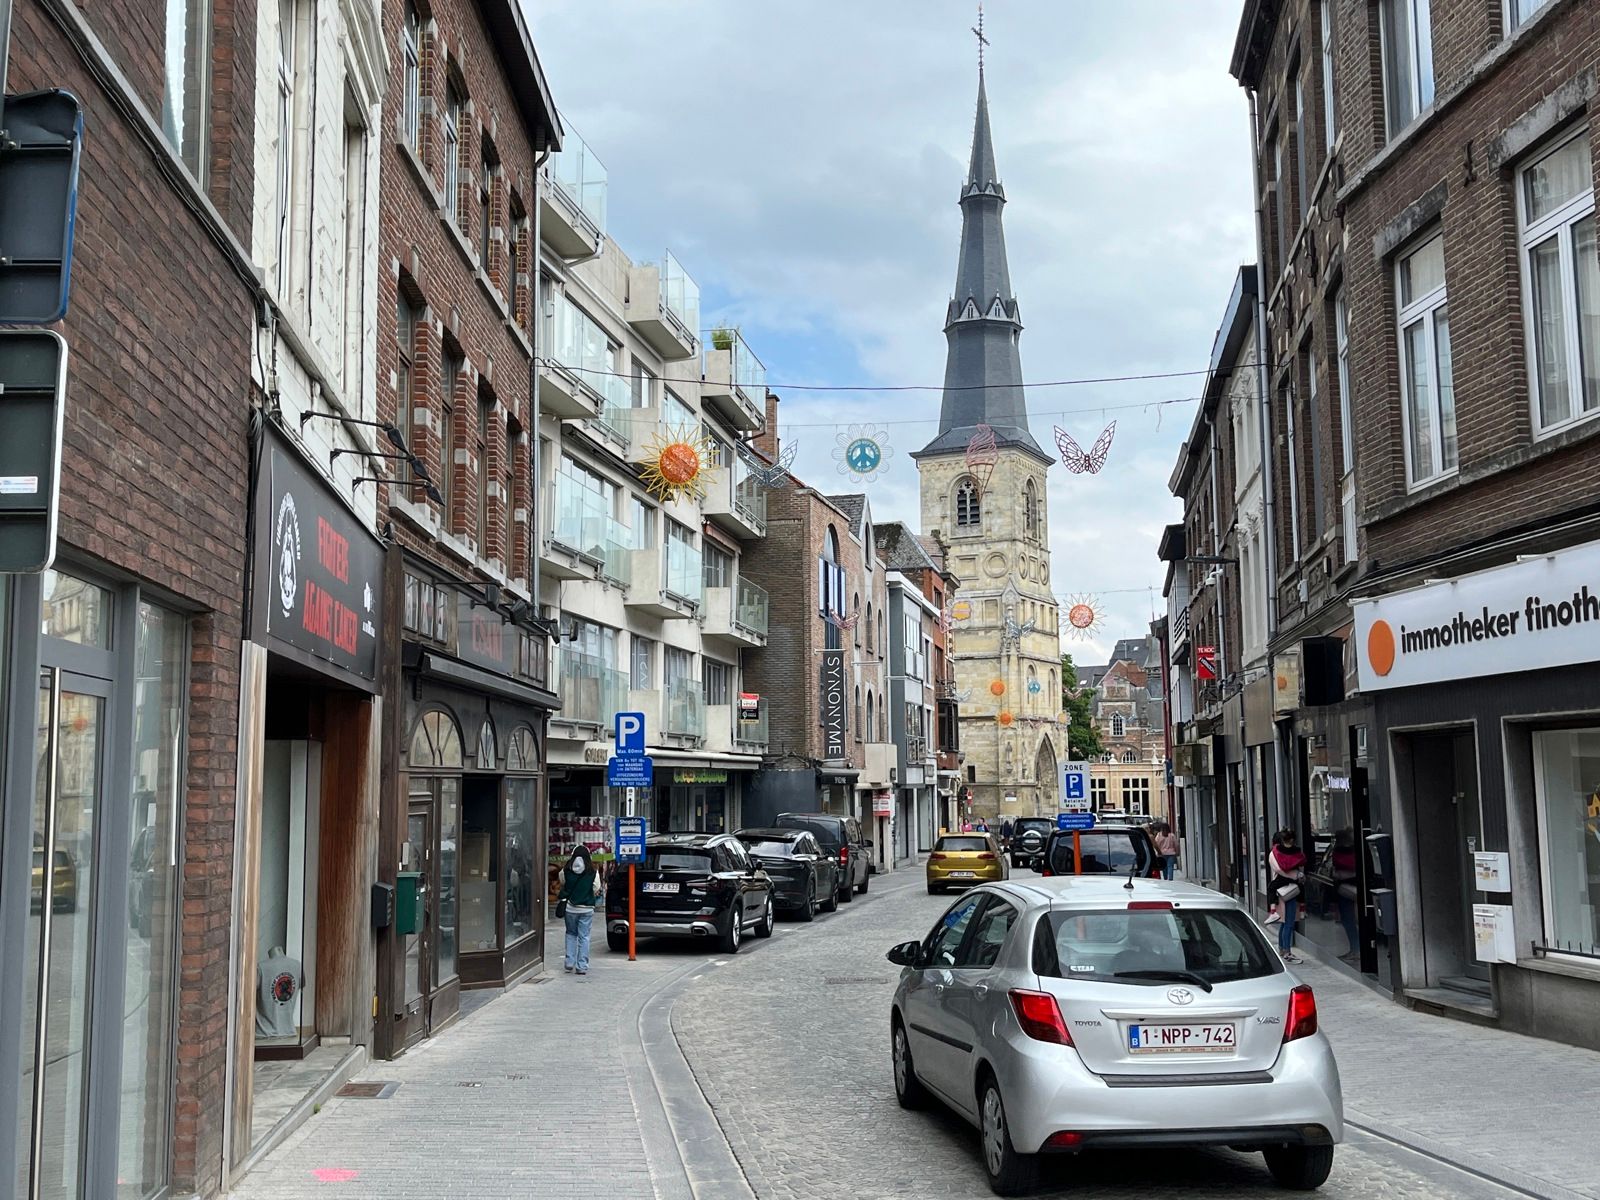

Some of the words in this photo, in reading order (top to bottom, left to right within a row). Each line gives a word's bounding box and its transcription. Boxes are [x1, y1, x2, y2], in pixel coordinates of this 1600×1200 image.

[1401, 606, 1520, 654] immotheker
[1524, 585, 1600, 632] finoth
[827, 656, 842, 755] SYNONYME
[619, 716, 641, 747] P
[1069, 775, 1079, 789] P
[1132, 1038, 1139, 1046] B
